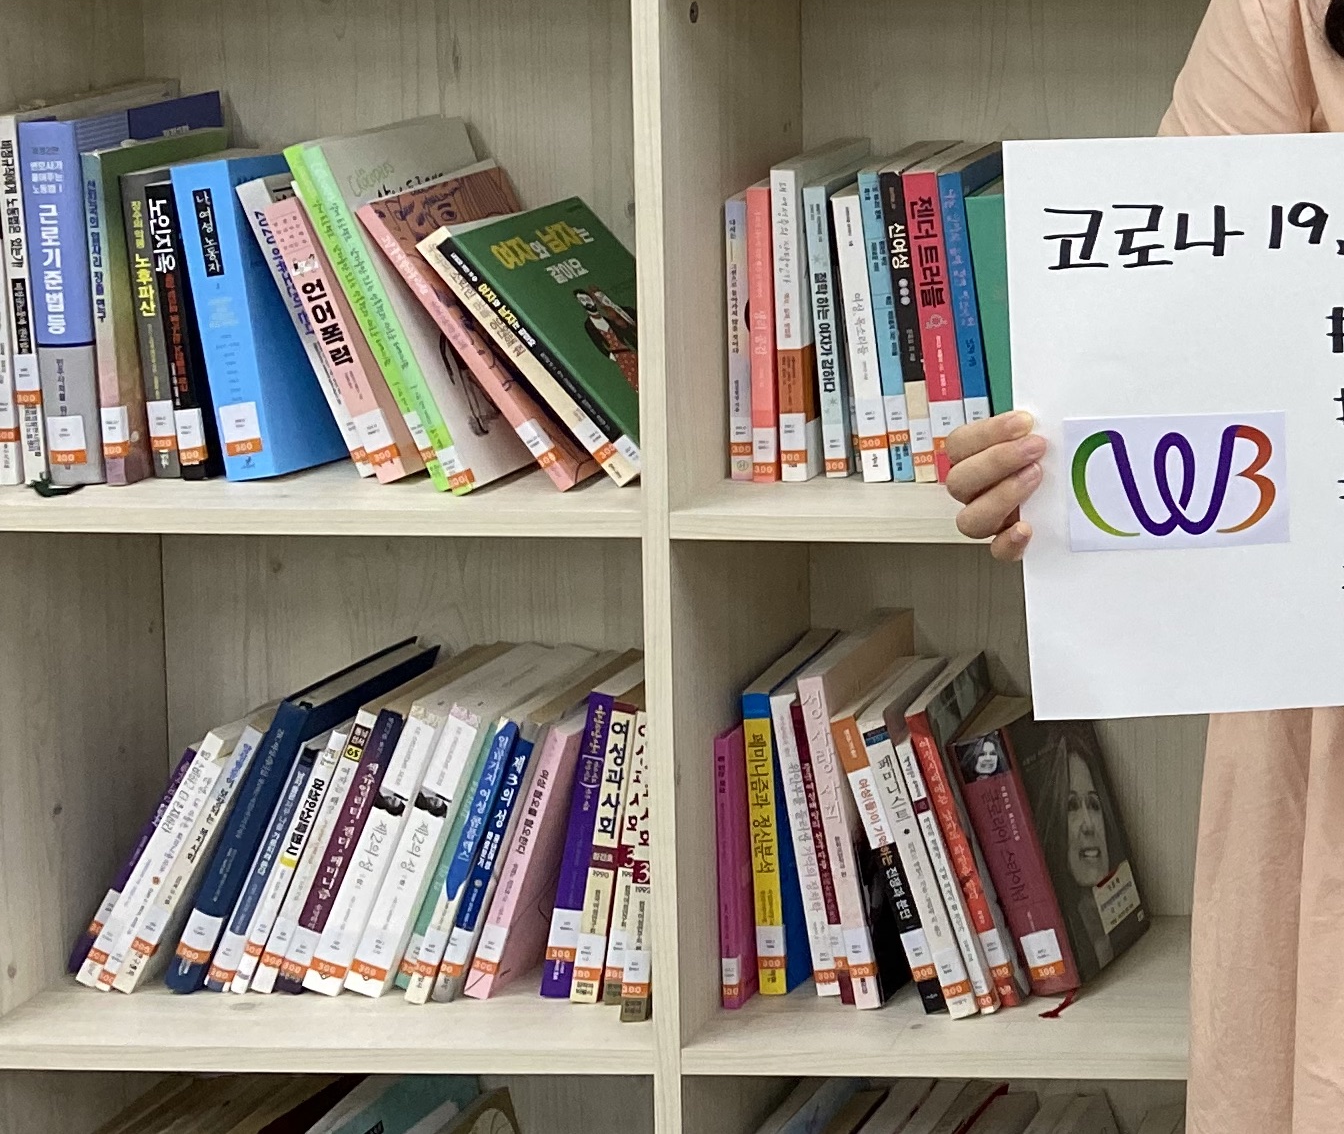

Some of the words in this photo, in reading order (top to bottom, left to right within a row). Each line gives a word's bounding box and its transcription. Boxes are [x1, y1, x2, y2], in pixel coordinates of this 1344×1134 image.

[149, 199, 176, 274] 노인지옥
[888, 223, 910, 269] 신여성
[909, 196, 935, 241] 젠더
[1044, 205, 1244, 270] 코로나
[38, 204, 67, 335] 근로기준법등
[135, 254, 157, 317] 노후파산
[917, 245, 946, 308] 트러블
[301, 277, 354, 367] 언어폭력
[861, 438, 881, 448] 300
[748, 733, 768, 809] 페미니즘과
[752, 814, 776, 874] 정신분석
